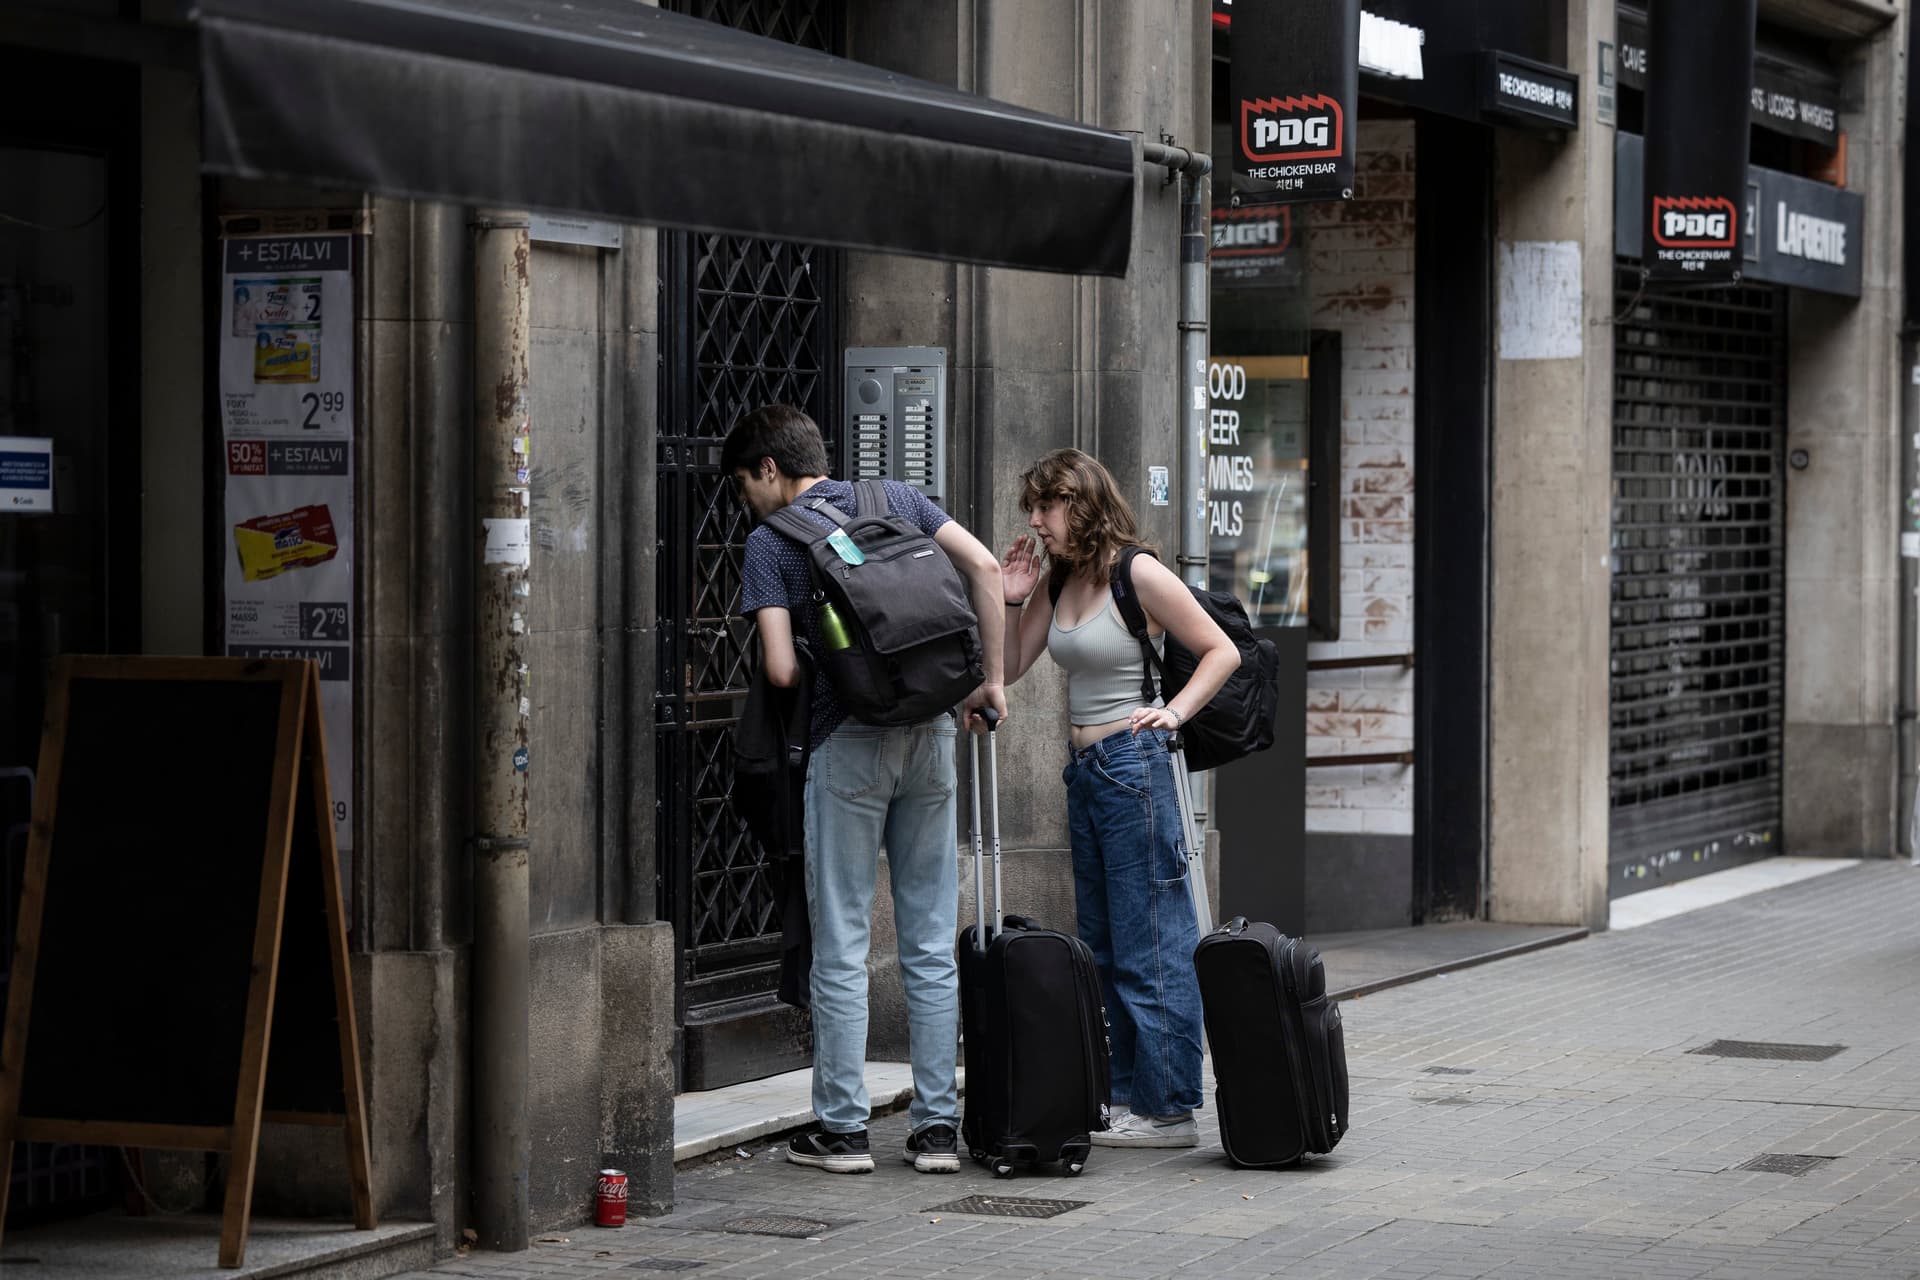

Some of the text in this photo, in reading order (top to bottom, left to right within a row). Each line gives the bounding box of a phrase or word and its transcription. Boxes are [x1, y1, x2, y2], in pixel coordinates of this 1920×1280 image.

[1499, 73, 1513, 95] THE
[1513, 76, 1541, 103] CHICKEN
[1541, 85, 1554, 107] BAR
[1254, 117, 1328, 148] PDG
[1248, 163, 1336, 179] THE CHICKEN BAR
[1664, 211, 1726, 239] PDG
[258, 242, 332, 261] ESTALVI
[1658, 250, 1731, 261] THE CHICKEN BAR
[1209, 362, 1245, 401] OOD
[1209, 408, 1240, 446] EER
[285, 447, 342, 463] ESTALVI
